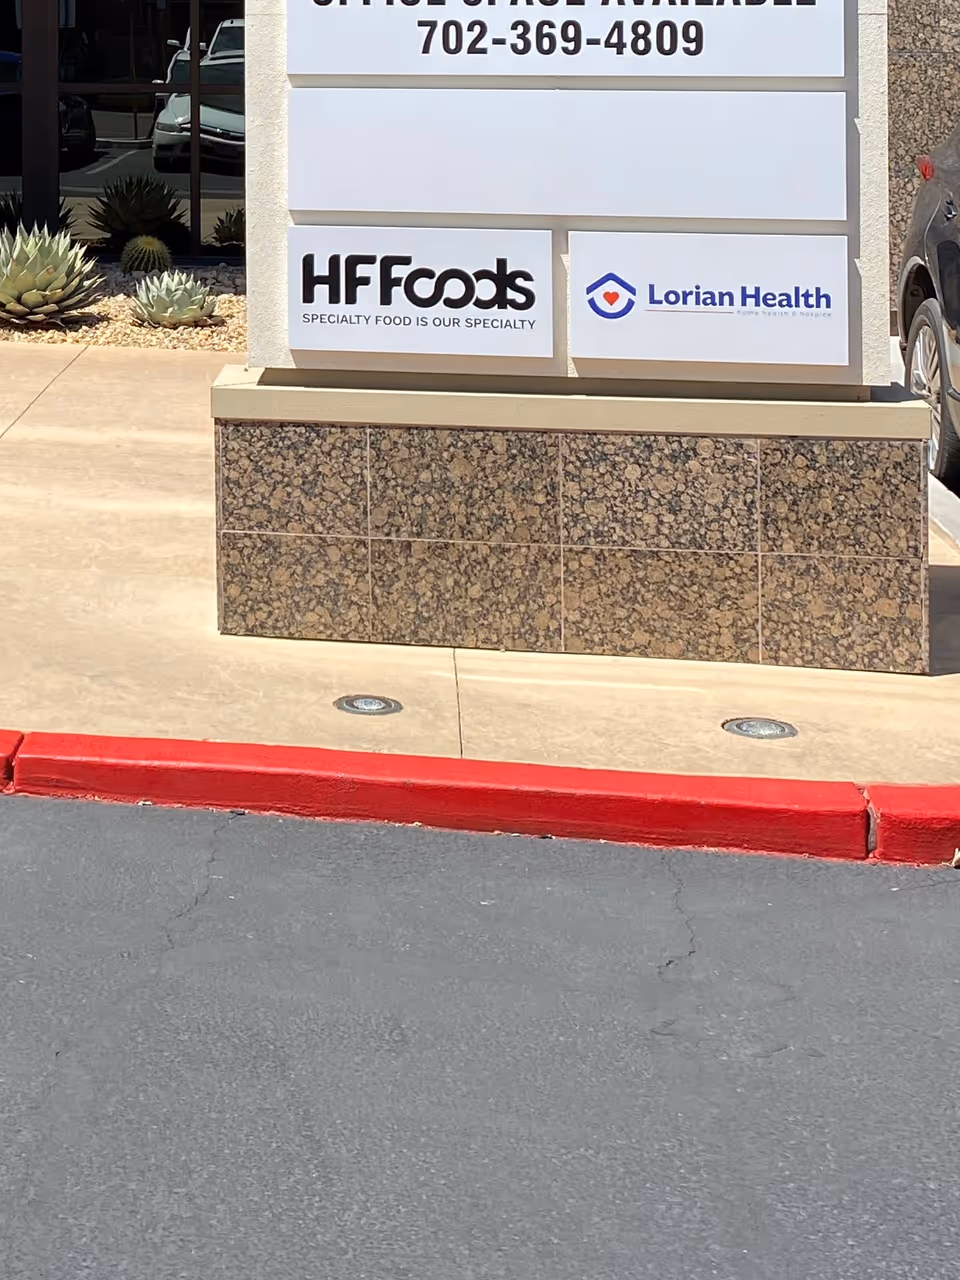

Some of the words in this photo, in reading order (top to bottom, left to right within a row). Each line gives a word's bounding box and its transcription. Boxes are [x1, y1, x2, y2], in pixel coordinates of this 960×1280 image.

[417, 19, 704, 57] 702-369-4809
[647, 283, 735, 308] Lorian
[740, 285, 832, 309] Health
[302, 313, 372, 325] SPECIALTY
[375, 315, 412, 326] FOOD
[416, 316, 429, 327] IS
[432, 317, 461, 328] OUR
[464, 318, 537, 330] SPECIALTY
